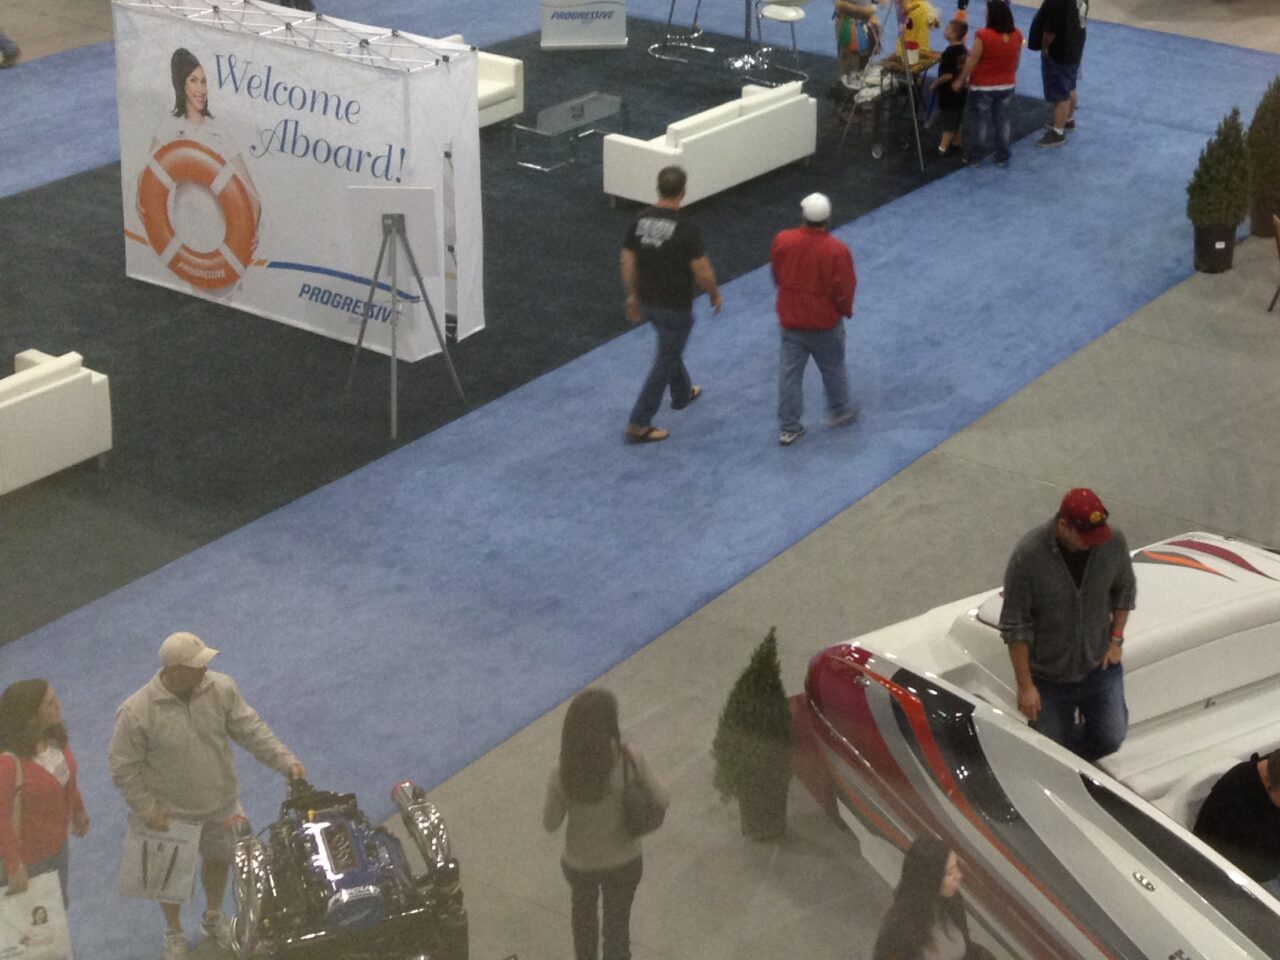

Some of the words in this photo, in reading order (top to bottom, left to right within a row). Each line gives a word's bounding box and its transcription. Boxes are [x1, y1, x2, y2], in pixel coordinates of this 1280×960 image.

[551, 10, 615, 20] PROGRESSIVE
[214, 53, 361, 124] Welcome
[251, 119, 406, 183] Aboard!
